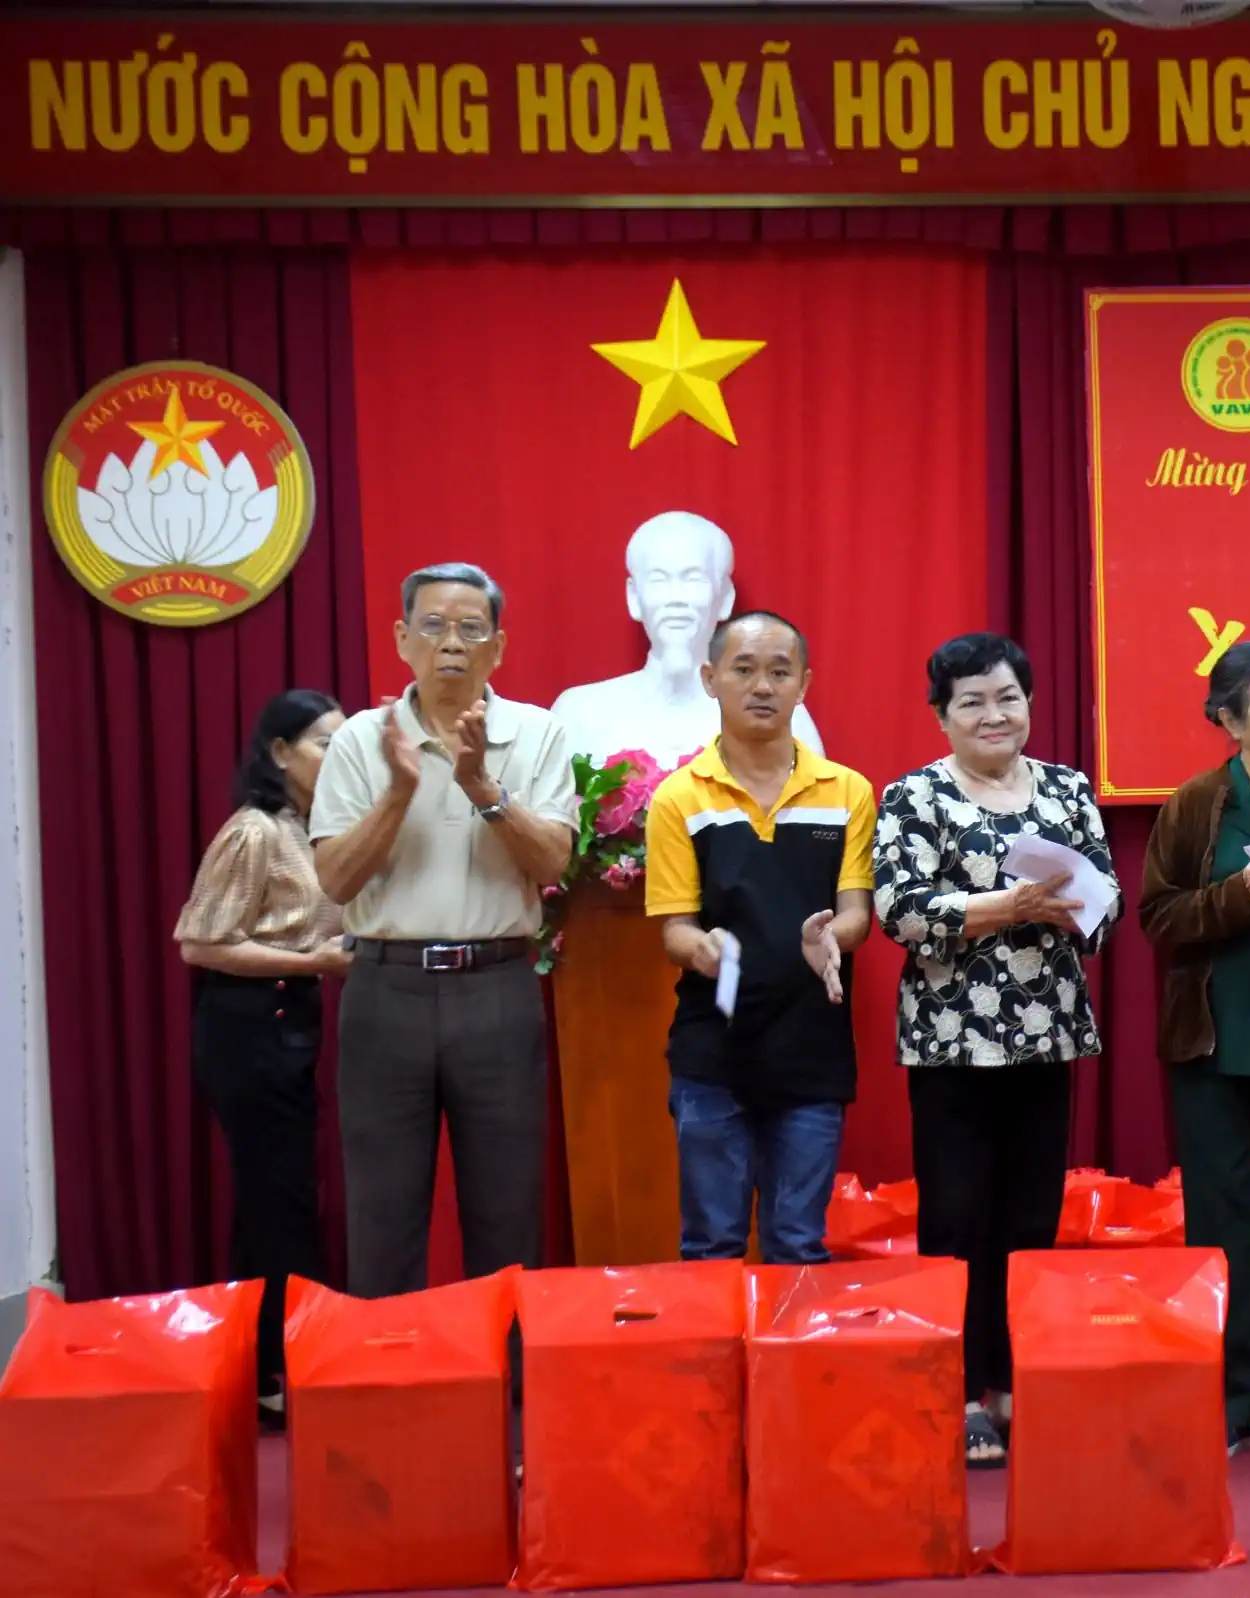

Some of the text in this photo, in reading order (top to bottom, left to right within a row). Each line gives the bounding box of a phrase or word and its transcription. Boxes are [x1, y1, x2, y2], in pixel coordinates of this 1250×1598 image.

[30, 34, 250, 153] NƯỚC
[280, 41, 489, 173] CỘNG
[517, 38, 671, 154] HÒA
[700, 41, 804, 151] XÃ
[833, 37, 954, 173] HỘI
[983, 29, 1131, 150] CHỦ
[1146, 446, 1248, 496] Mừng
[179, 575, 227, 600] NAM
